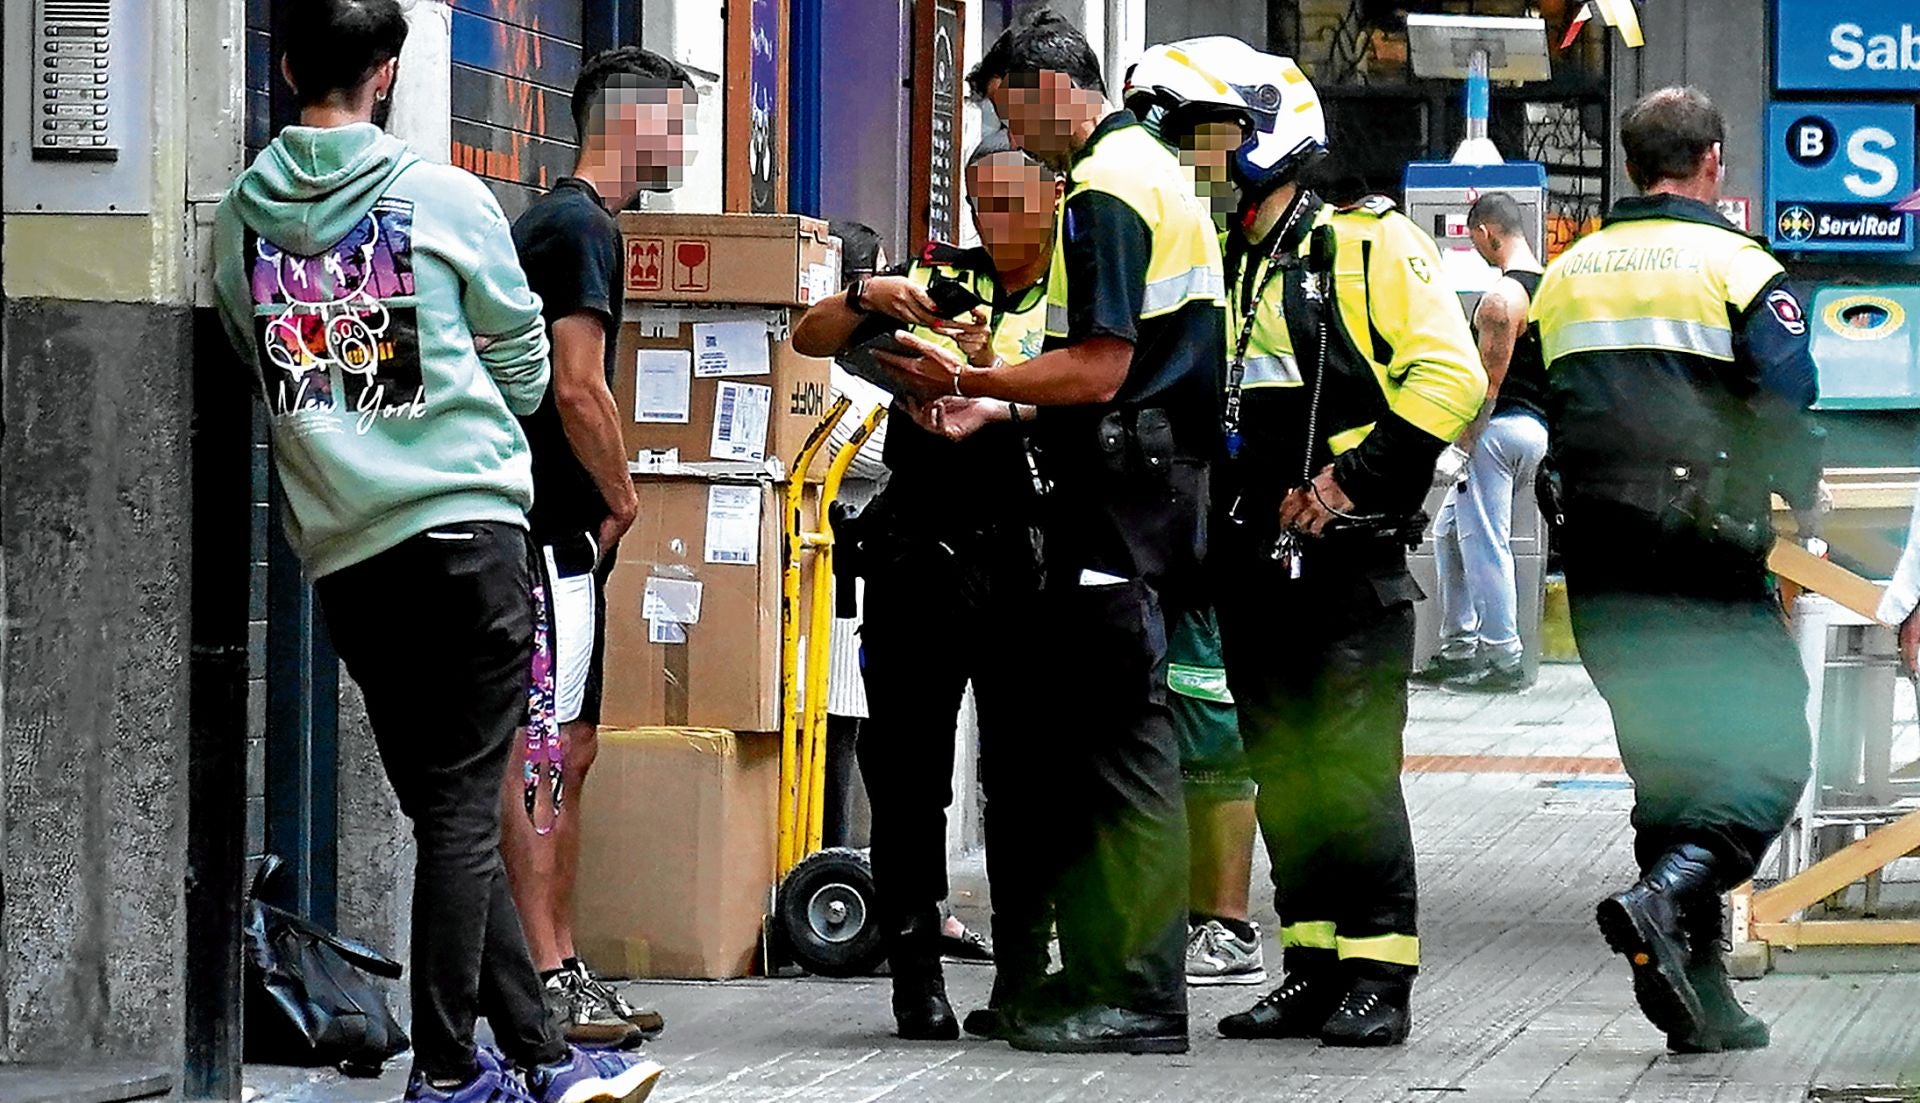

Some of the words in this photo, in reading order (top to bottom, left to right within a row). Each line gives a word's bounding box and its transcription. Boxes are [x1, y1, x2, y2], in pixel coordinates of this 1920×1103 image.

[1827, 22, 1920, 70] Sab
[1800, 127, 1824, 157] B
[1843, 127, 1899, 197] S
[1818, 215, 1902, 236] ServiRed
[278, 378, 338, 417] New
[356, 384, 427, 436] York
[791, 381, 824, 416] HOFF
